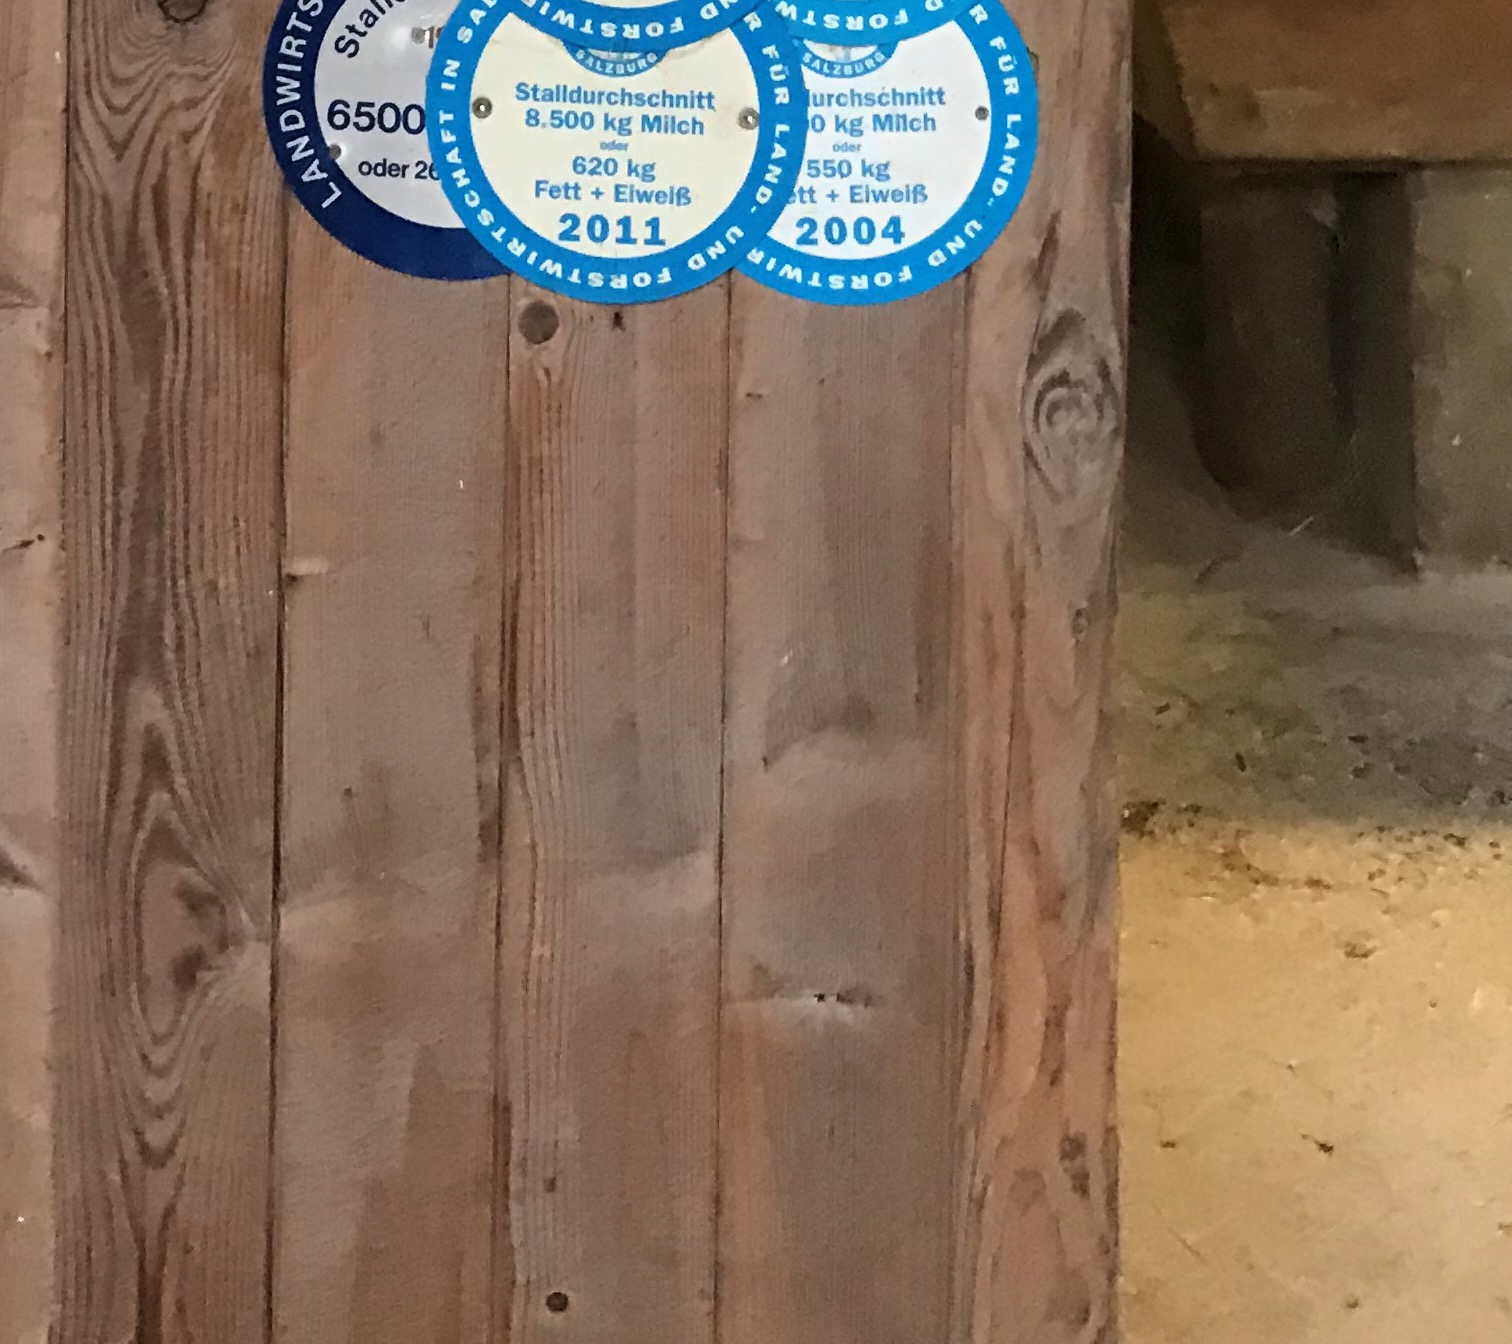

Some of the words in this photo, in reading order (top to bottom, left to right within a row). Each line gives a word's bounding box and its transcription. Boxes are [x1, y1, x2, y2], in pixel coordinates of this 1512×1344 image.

[762, 45, 790, 104] FÜR
[516, 82, 715, 110] Stalldurchschnitt
[526, 108, 594, 130] 8.500
[604, 113, 632, 136] kg
[642, 115, 704, 135] Milch
[573, 156, 618, 176] 620
[627, 159, 655, 182] kg
[535, 180, 581, 200] Fett
[614, 184, 691, 206] Eiweiß
[559, 213, 665, 246] 2011
[796, 216, 905, 245] 2004
[687, 224, 744, 272] UND
